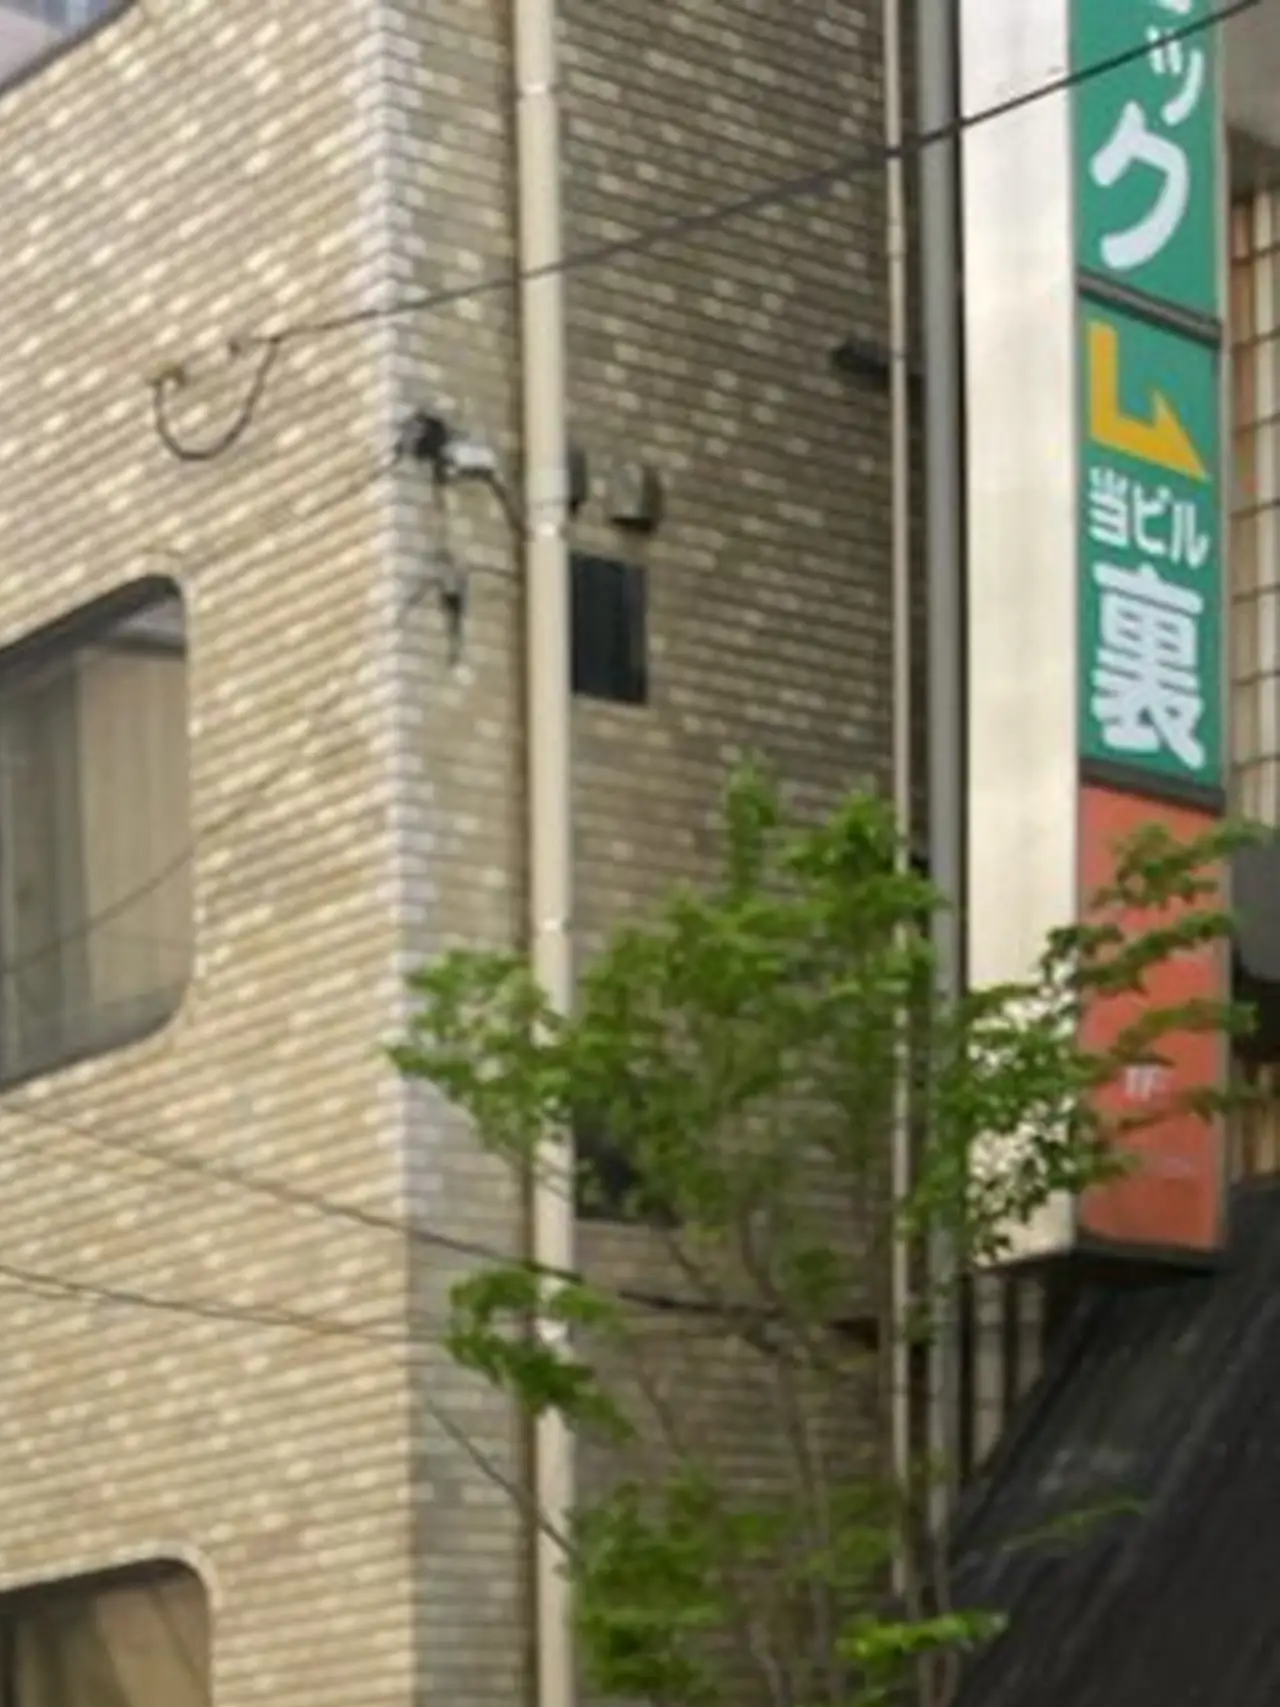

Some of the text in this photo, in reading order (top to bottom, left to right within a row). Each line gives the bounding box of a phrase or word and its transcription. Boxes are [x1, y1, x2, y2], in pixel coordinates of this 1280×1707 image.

[1090, 0, 1205, 270] ック
[1088, 465, 1210, 570] 当ビル
[1090, 558, 1206, 771] 裏
